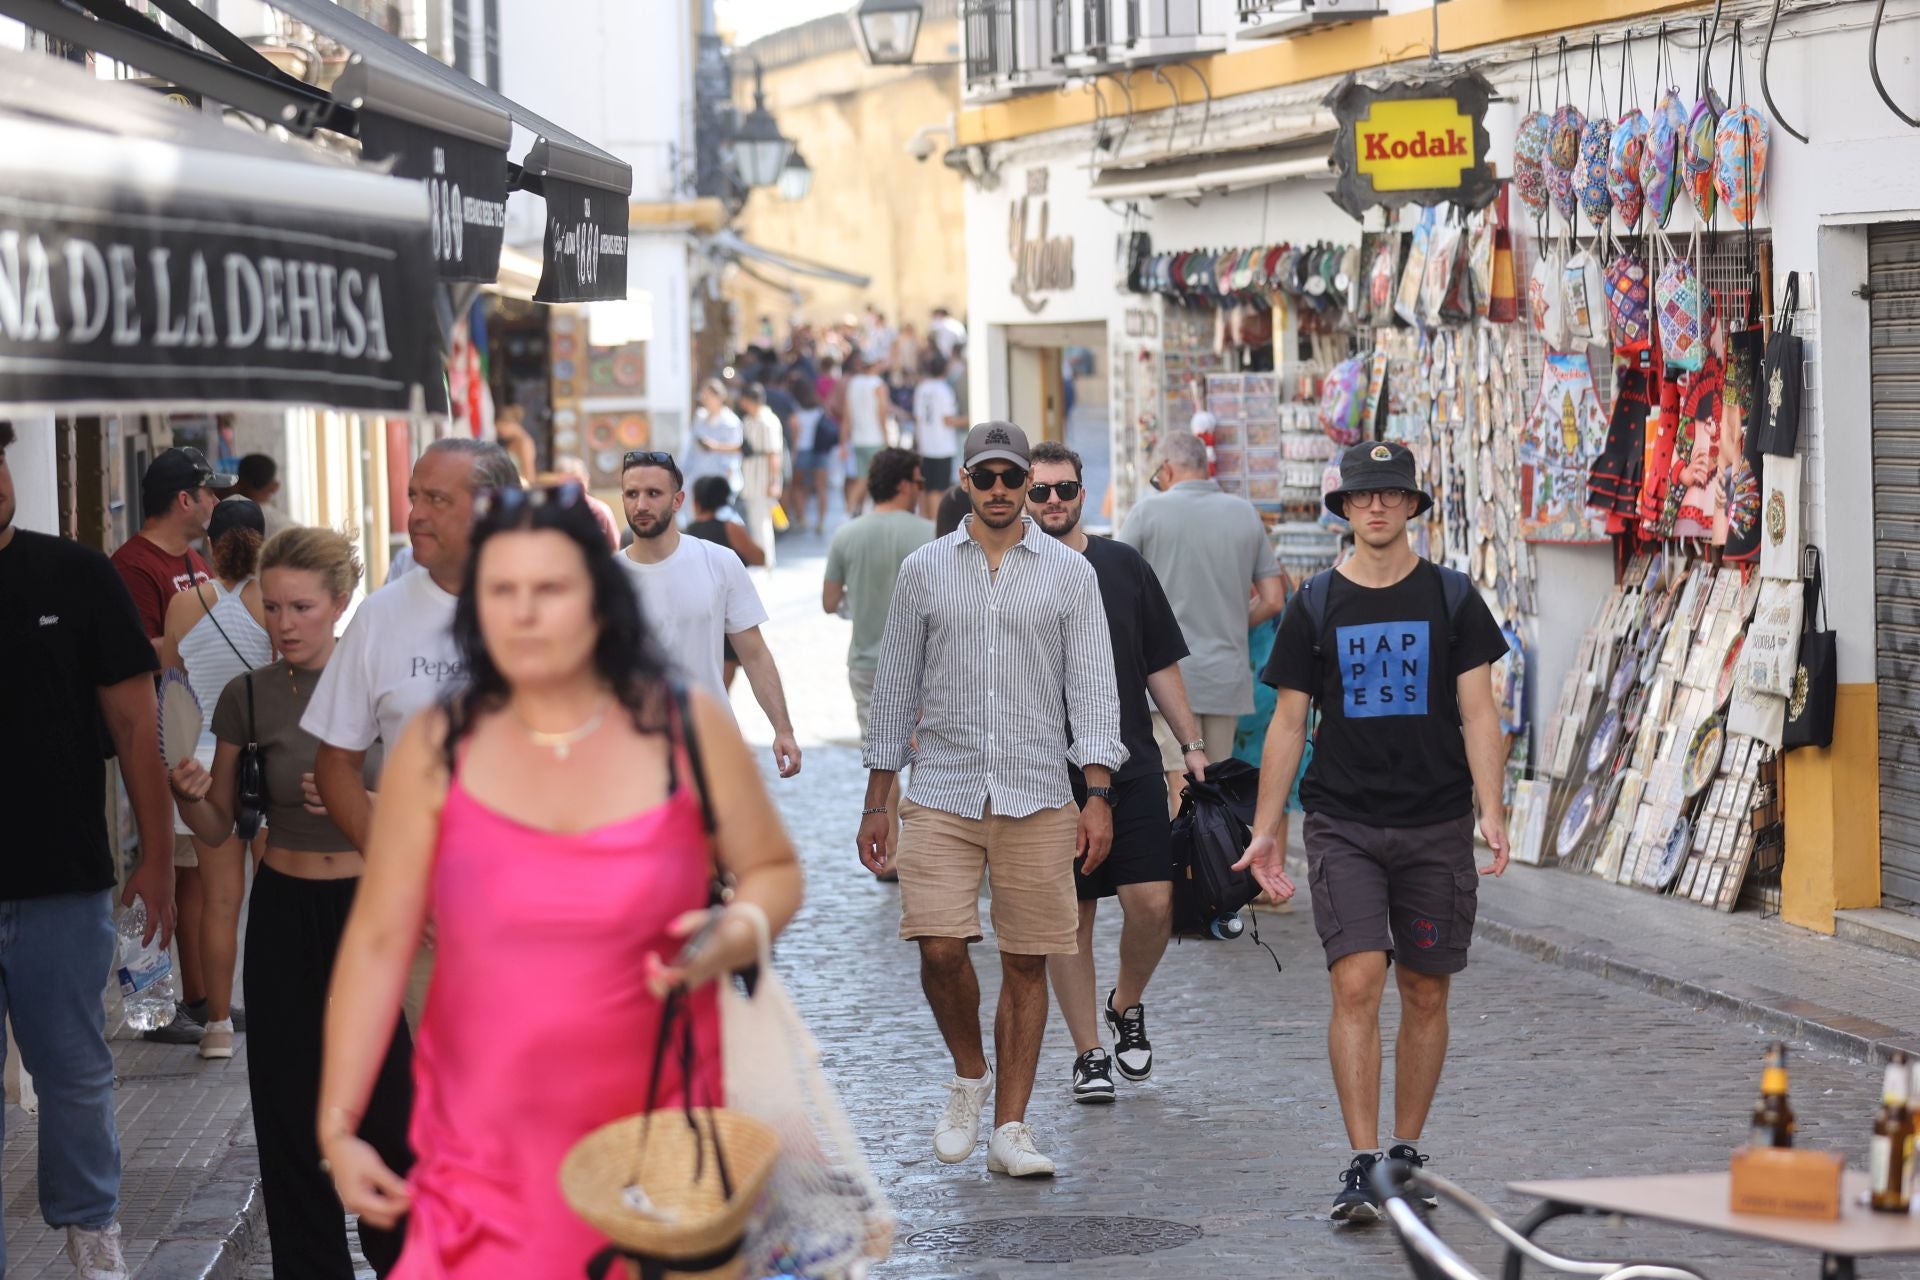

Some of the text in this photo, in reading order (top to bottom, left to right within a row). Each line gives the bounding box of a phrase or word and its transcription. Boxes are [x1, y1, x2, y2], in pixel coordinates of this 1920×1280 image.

[1364, 129, 1467, 161] Kodak
[576, 222, 599, 286] 1880
[64, 238, 141, 346] DE
[151, 247, 217, 347] LA
[224, 252, 392, 362] DEHESA
